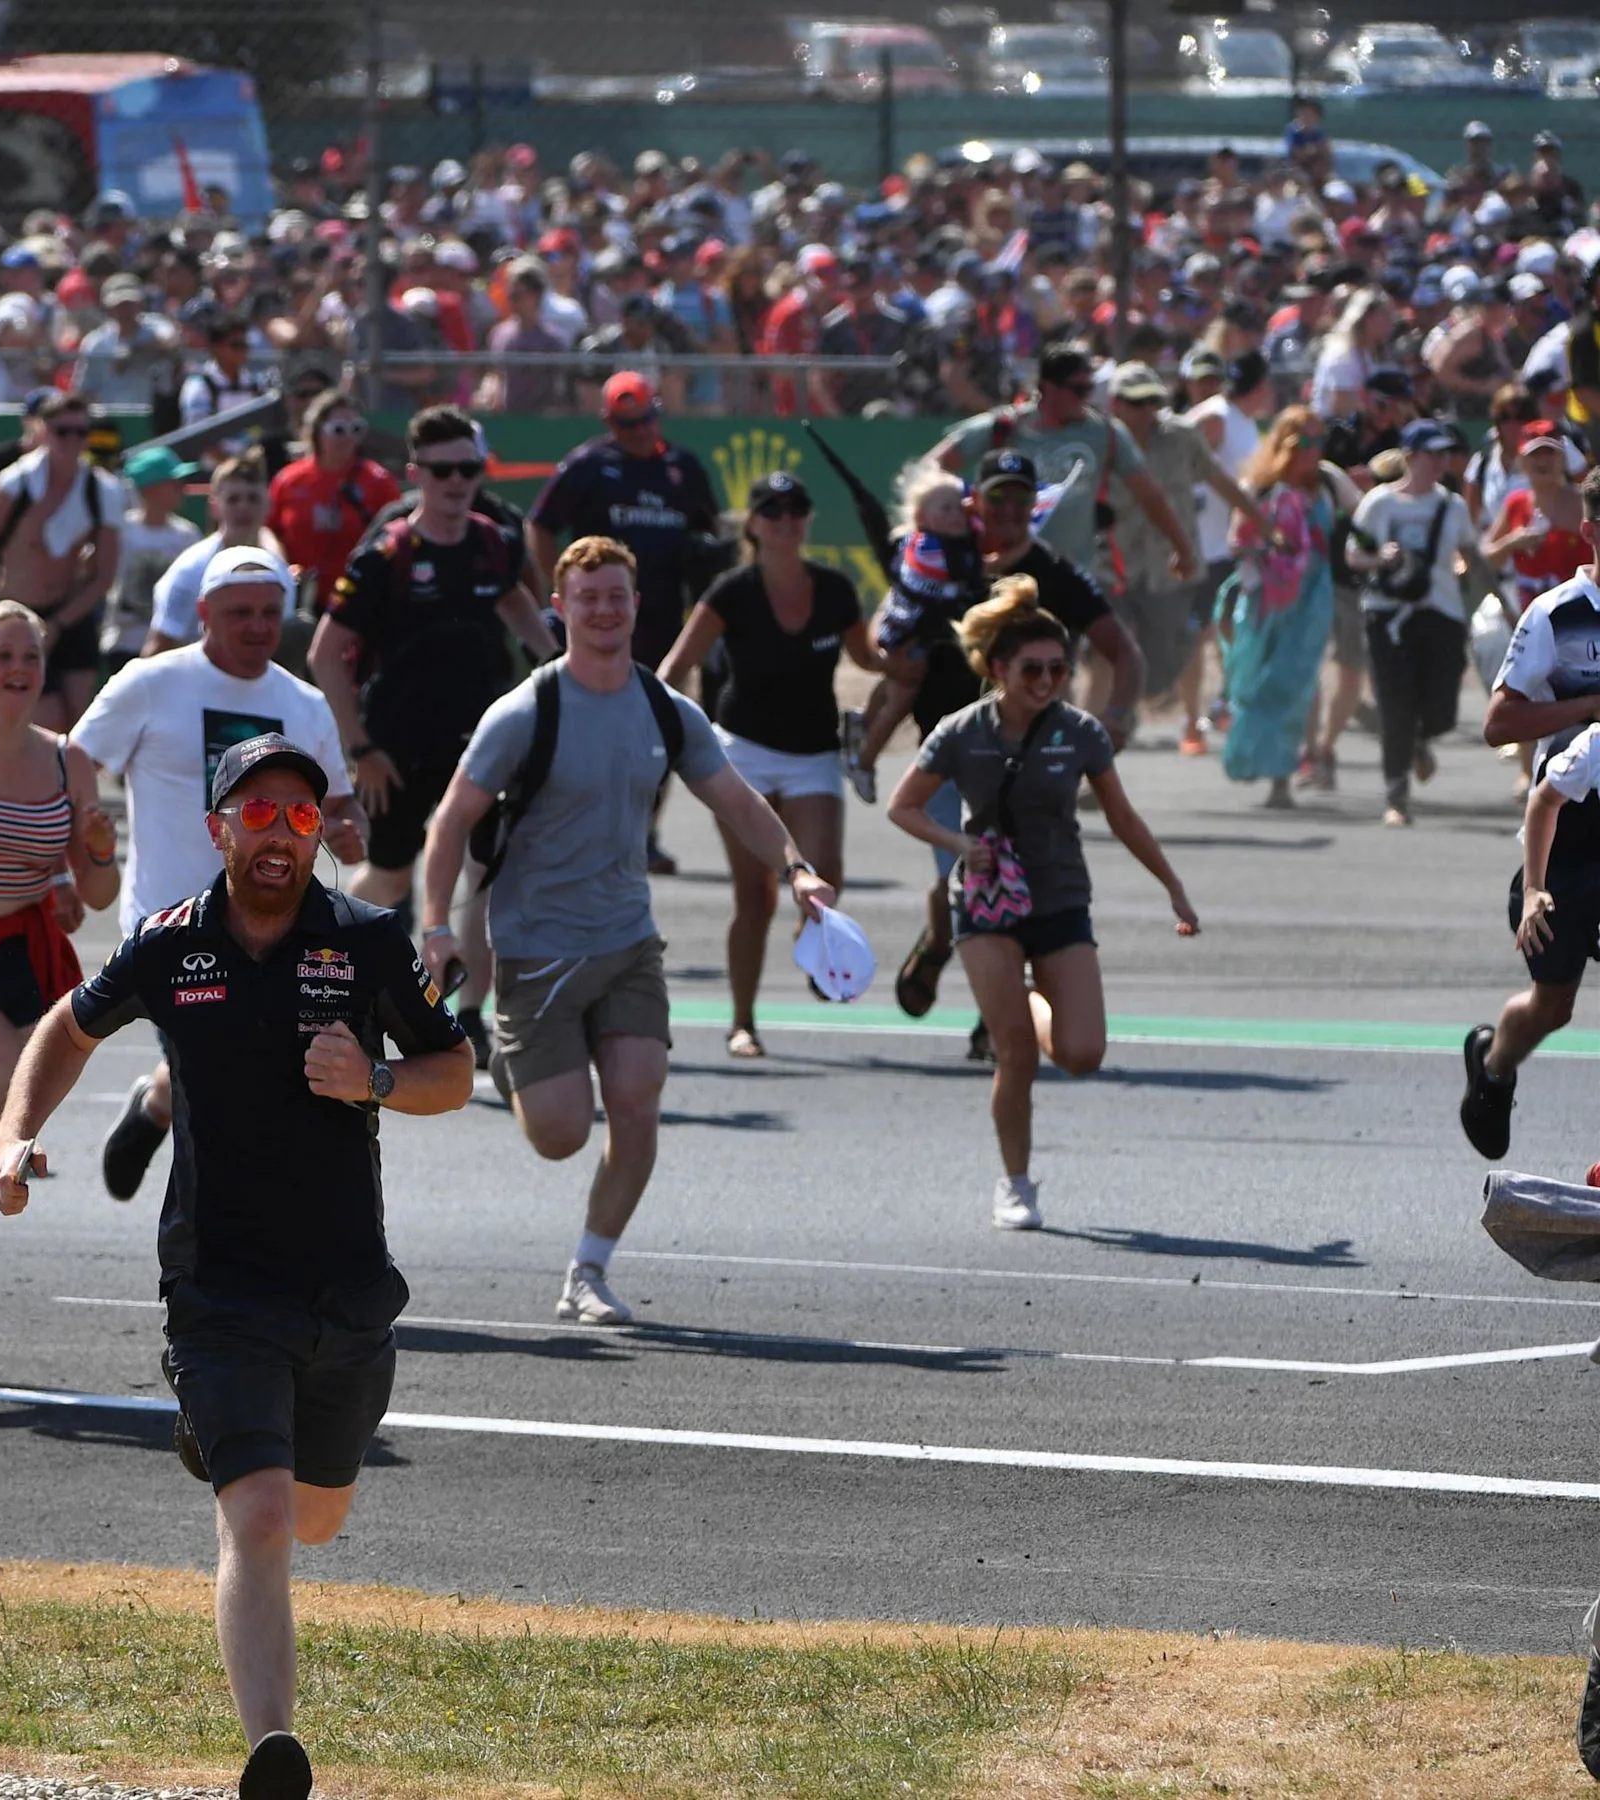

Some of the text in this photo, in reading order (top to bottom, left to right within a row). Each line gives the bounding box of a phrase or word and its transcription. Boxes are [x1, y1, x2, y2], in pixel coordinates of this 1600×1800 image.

[241, 738, 270, 753] ASTON
[171, 970, 228, 984] INFINITI
[178, 990, 223, 1002] TOTAL
[300, 983, 350, 999] Pepe Jeans
